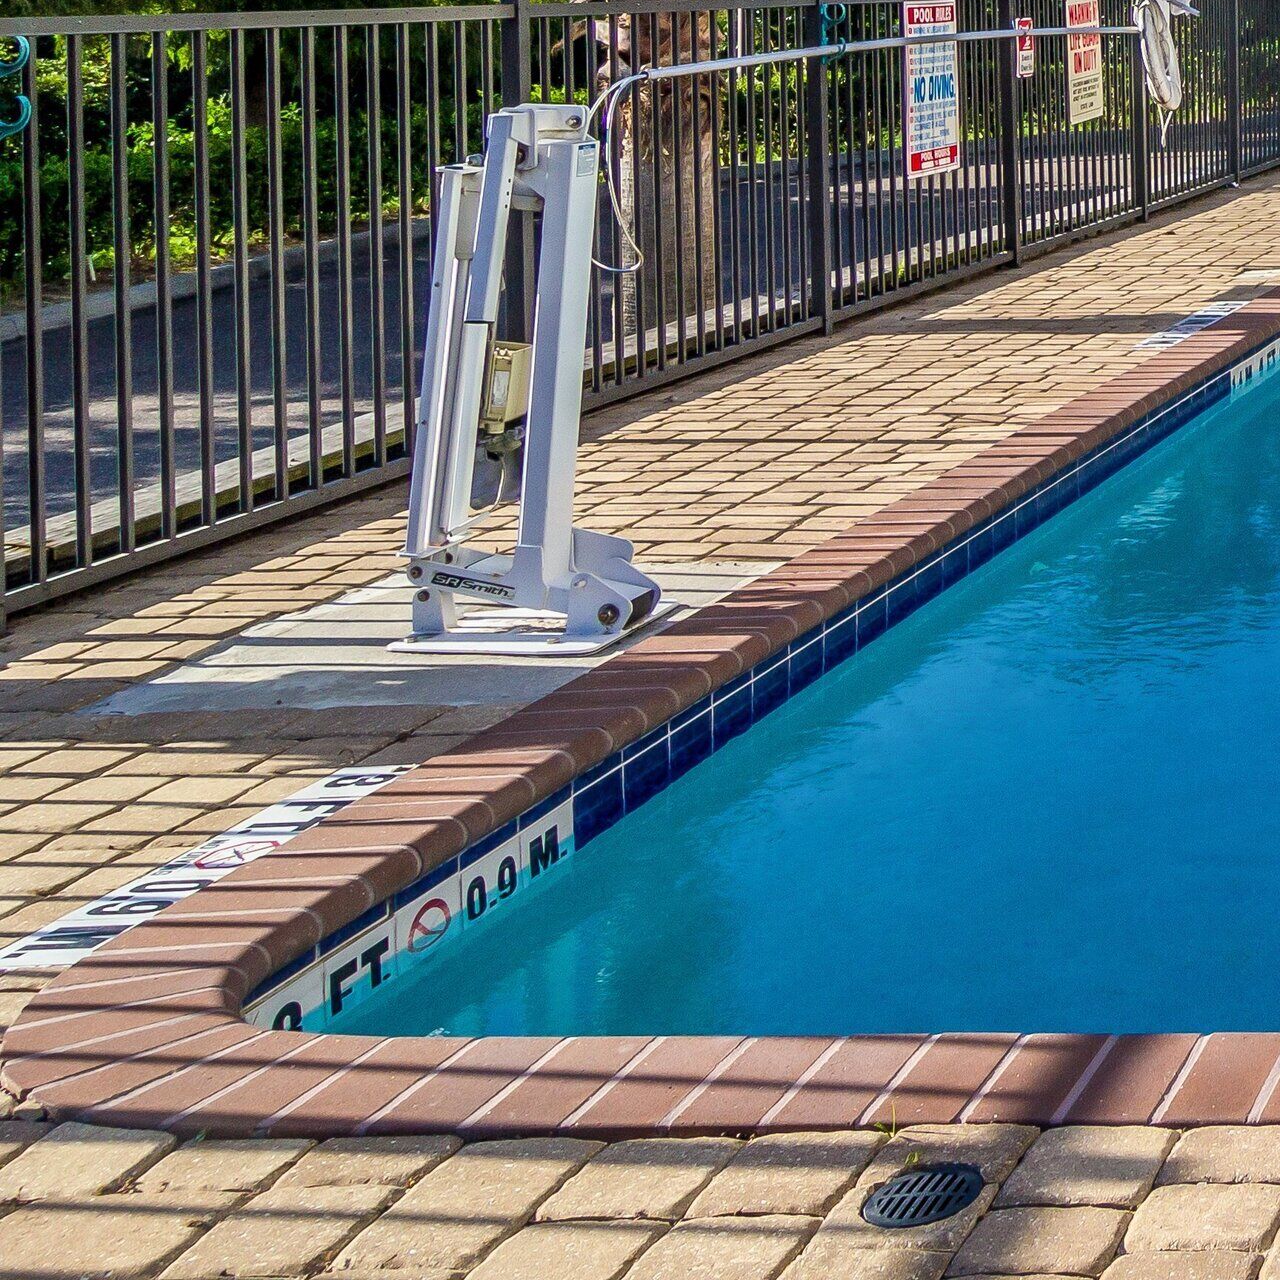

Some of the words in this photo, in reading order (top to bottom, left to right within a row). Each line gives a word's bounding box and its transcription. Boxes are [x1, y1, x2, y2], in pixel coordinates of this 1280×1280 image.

[913, 7, 935, 23] POOL
[935, 6, 952, 22] RULES
[914, 76, 926, 103] NO
[434, 573, 460, 588] SR
[86, 879, 215, 916] 0.9
[466, 855, 517, 921] 0.9
